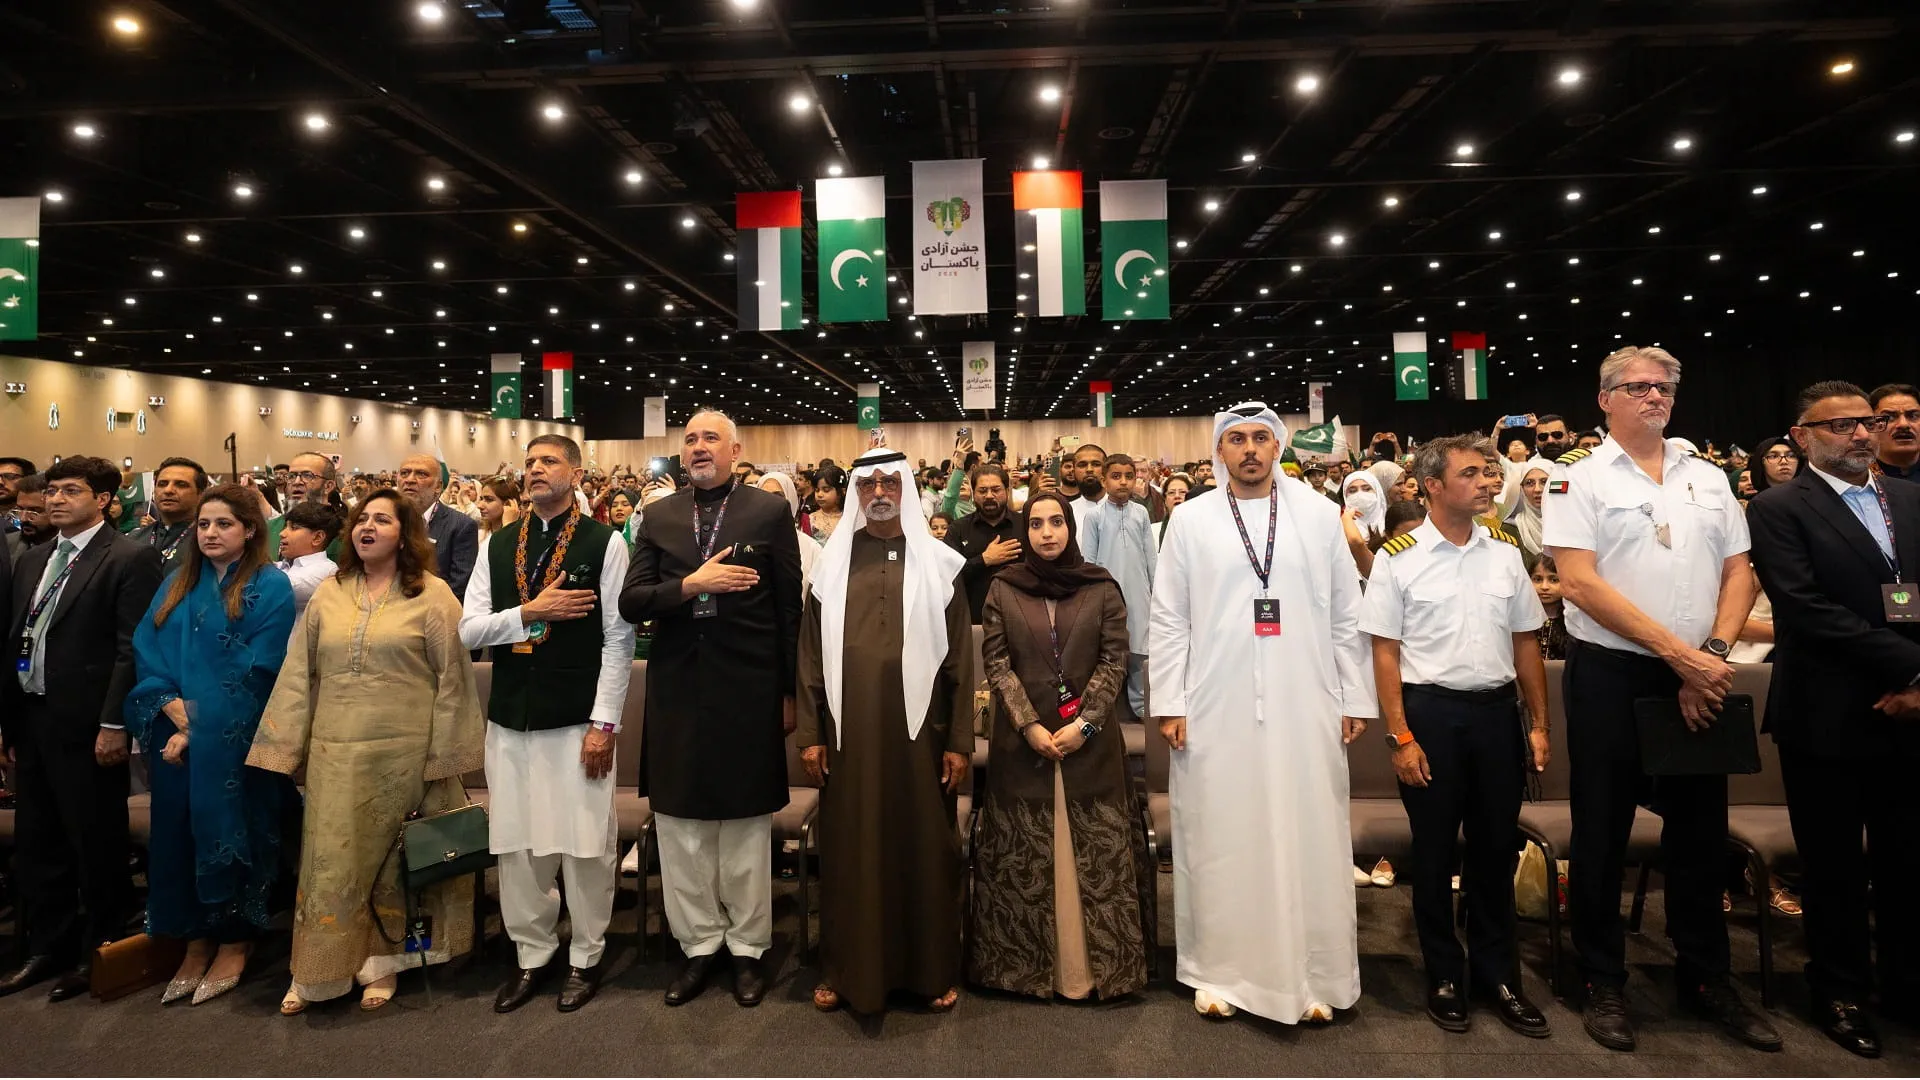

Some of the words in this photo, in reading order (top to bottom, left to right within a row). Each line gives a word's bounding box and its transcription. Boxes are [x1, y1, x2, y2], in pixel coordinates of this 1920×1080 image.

[921, 242, 949, 256] آزادی
[951, 242, 979, 255] جشن
[921, 256, 980, 271] پاکستان
